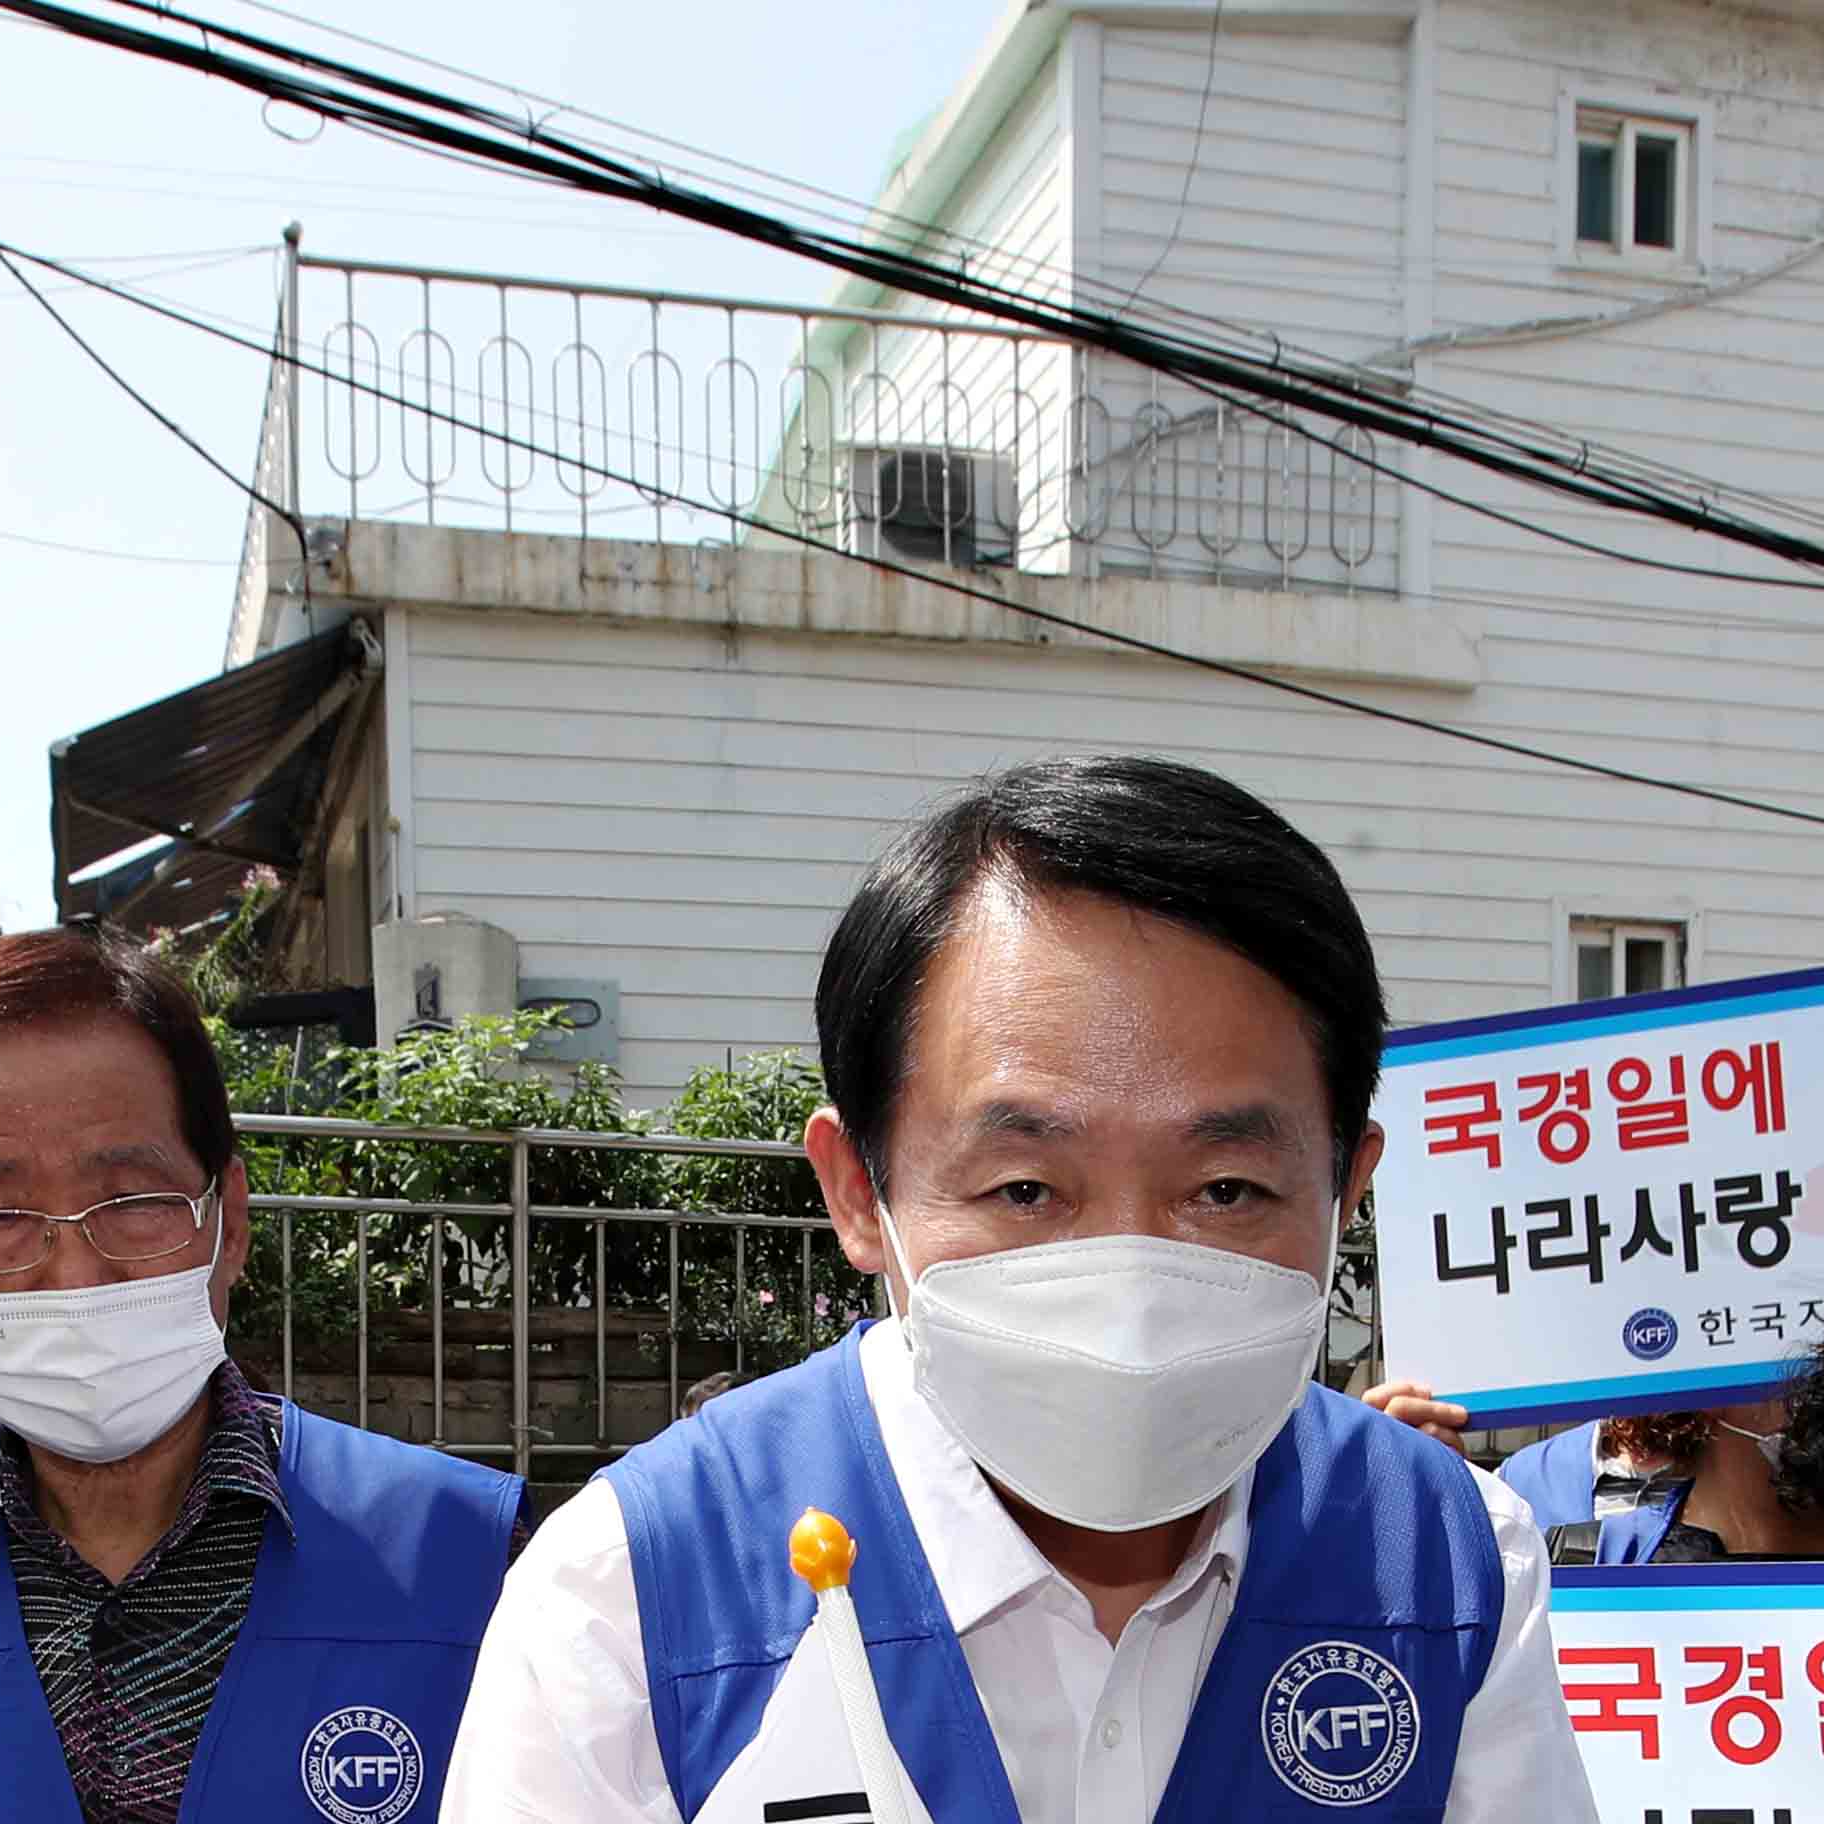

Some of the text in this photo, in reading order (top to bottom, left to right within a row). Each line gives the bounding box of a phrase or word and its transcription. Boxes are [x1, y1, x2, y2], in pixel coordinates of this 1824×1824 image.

[1424, 1041, 1787, 1169] 국경일에
[1433, 1170, 1803, 1294] 나라사랑
[1632, 1326, 1671, 1345] KFF
[1276, 1647, 1394, 1697] 한국자유총연맹
[314, 1711, 409, 1747] 한국자유총연맹
[1295, 1703, 1387, 1752] KFF
[1367, 1699, 1412, 1792] FEDERATION
[328, 1755, 400, 1789] KFF
[379, 1755, 418, 1822] FEDERATION
